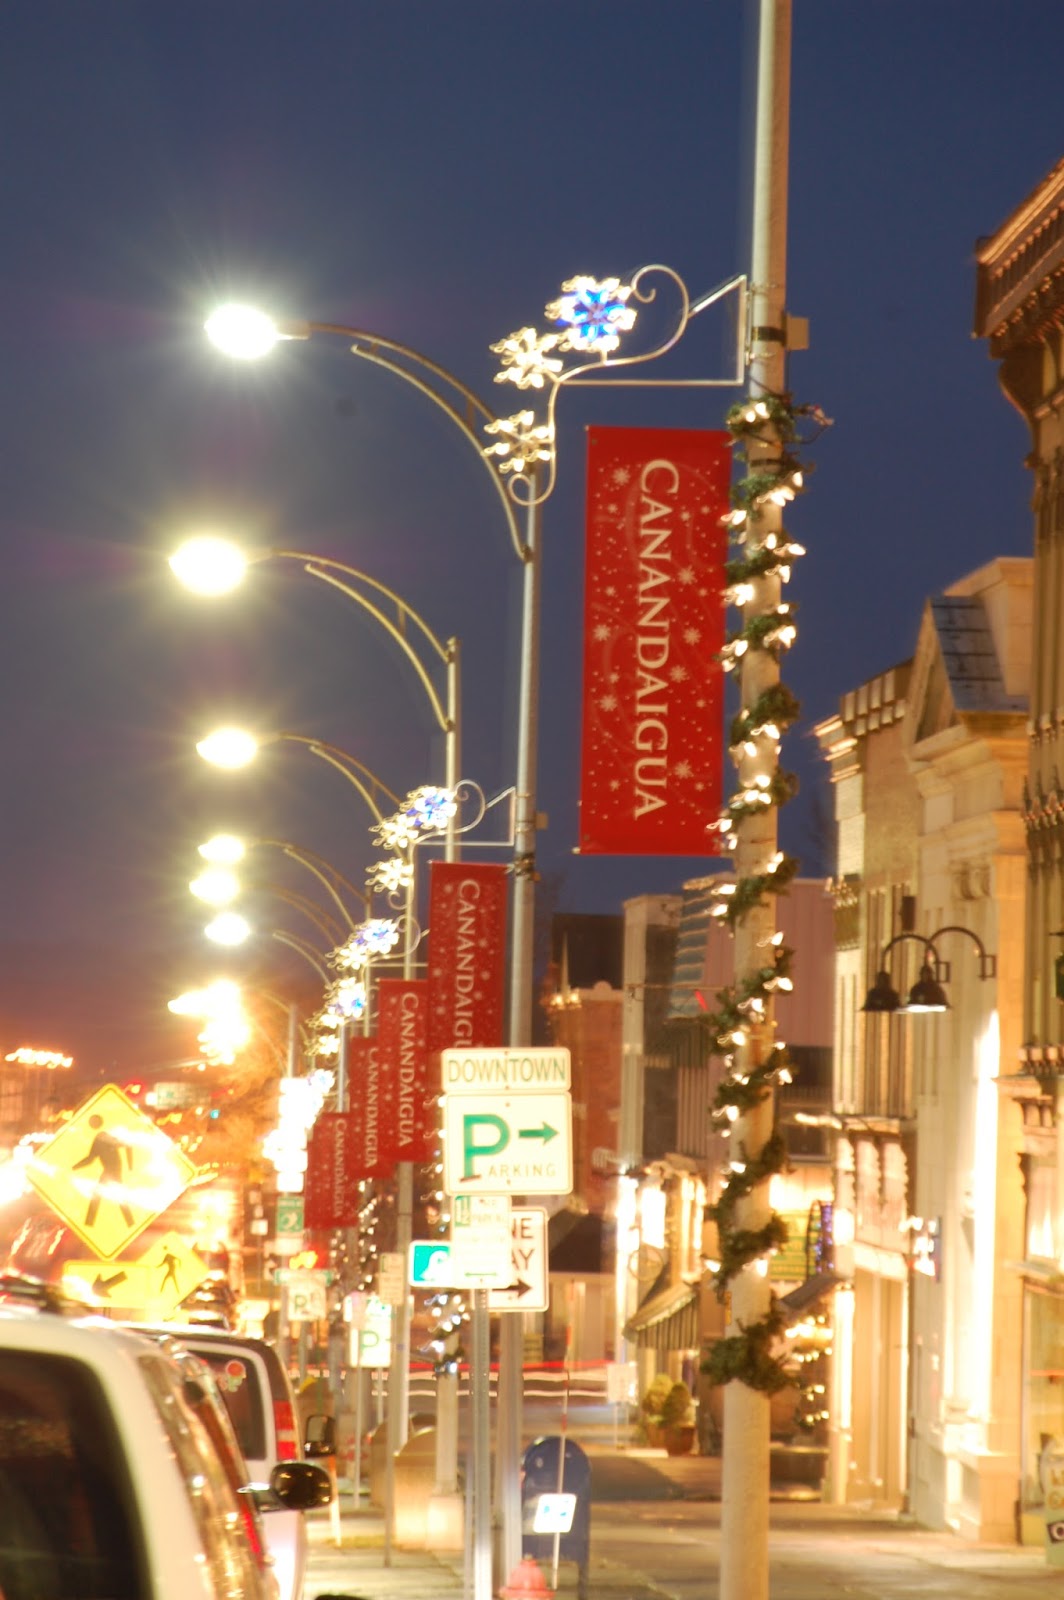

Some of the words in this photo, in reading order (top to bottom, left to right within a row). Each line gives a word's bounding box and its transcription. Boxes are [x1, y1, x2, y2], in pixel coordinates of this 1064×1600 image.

[633, 459, 680, 820] CANANDAIGUA
[453, 879, 481, 1048] CANANDAIG
[398, 992, 419, 1147] CANANDAIGUA
[448, 1057, 566, 1083] DOWNTOWN
